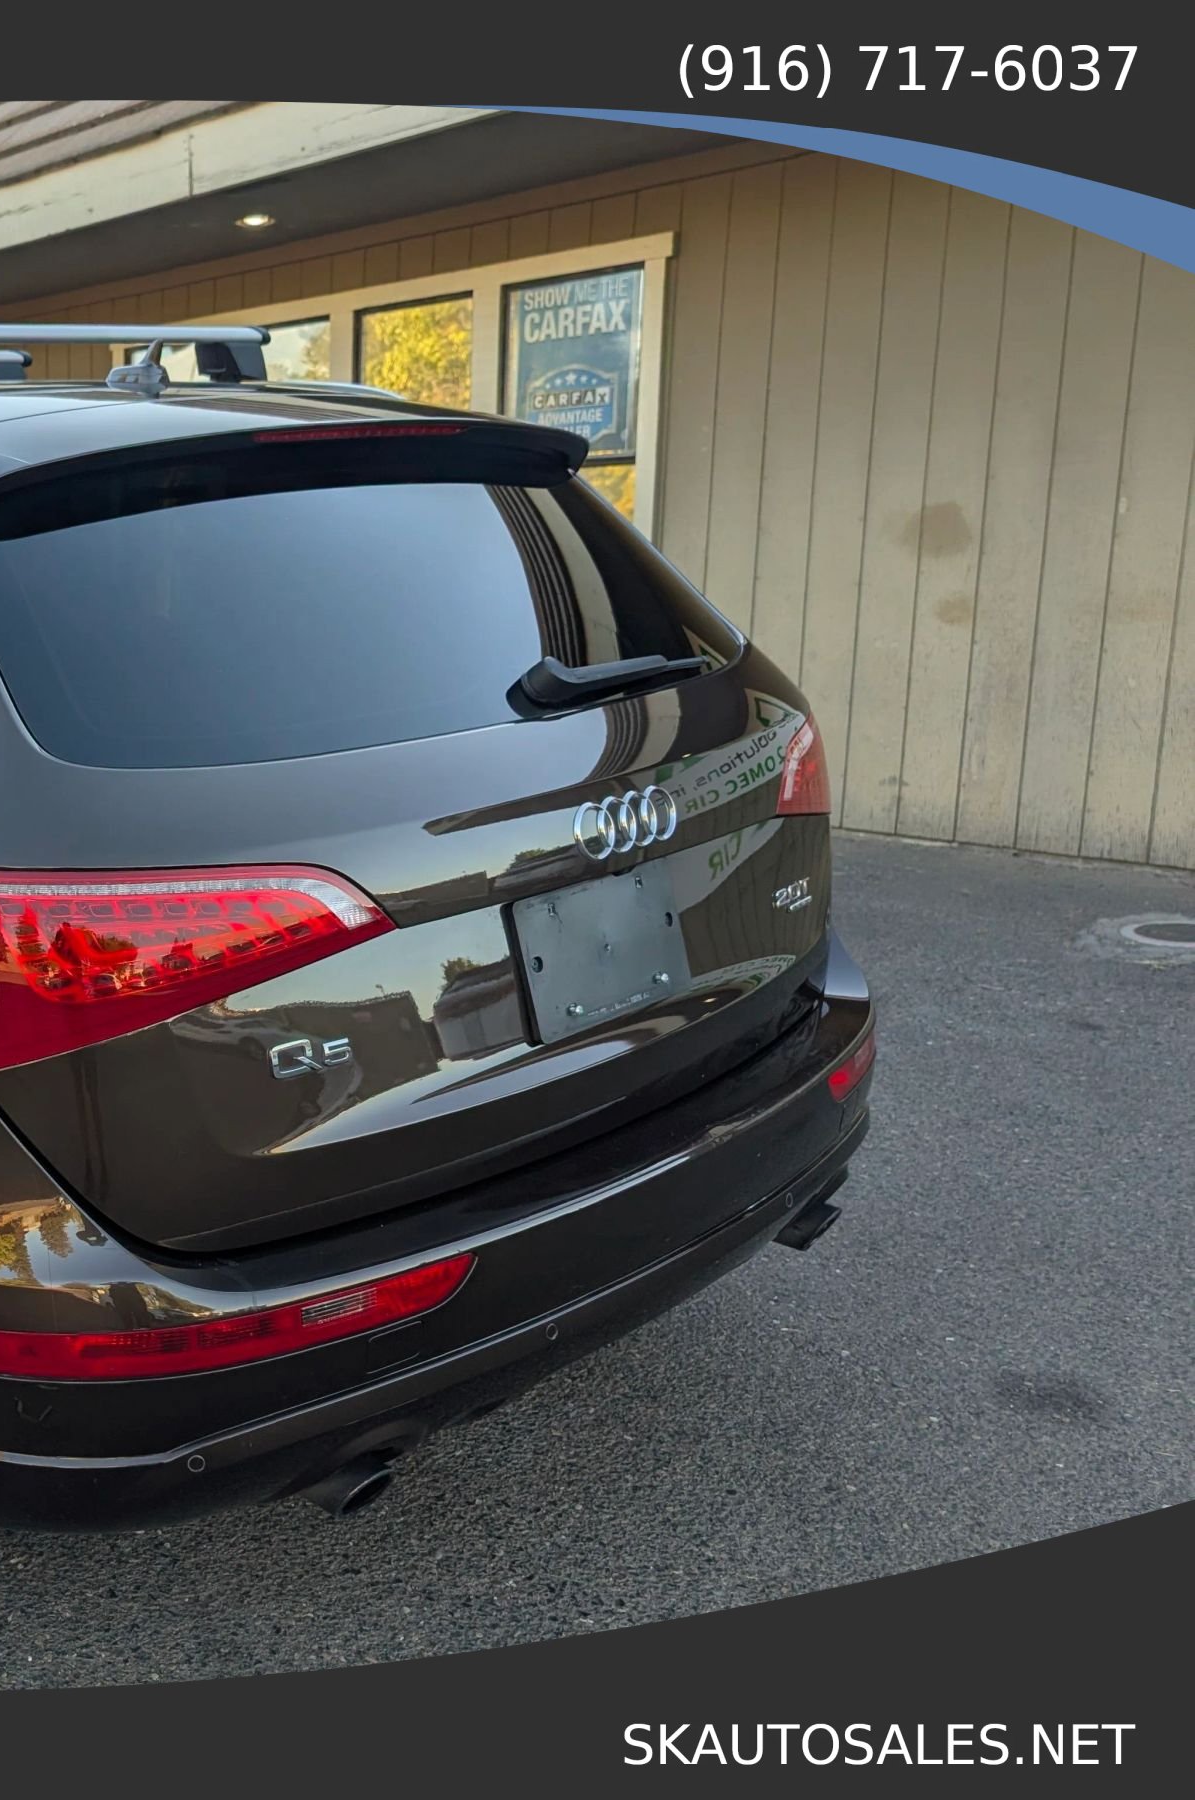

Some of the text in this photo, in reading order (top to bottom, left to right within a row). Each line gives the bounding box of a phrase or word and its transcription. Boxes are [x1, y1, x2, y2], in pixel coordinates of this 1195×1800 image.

[524, 277, 629, 311] SHOW ME THE
[524, 299, 629, 344] CARFAX
[533, 388, 609, 409] CARFAX
[538, 407, 603, 426] ADVANTAGE
[269, 1037, 352, 1079] Q5
